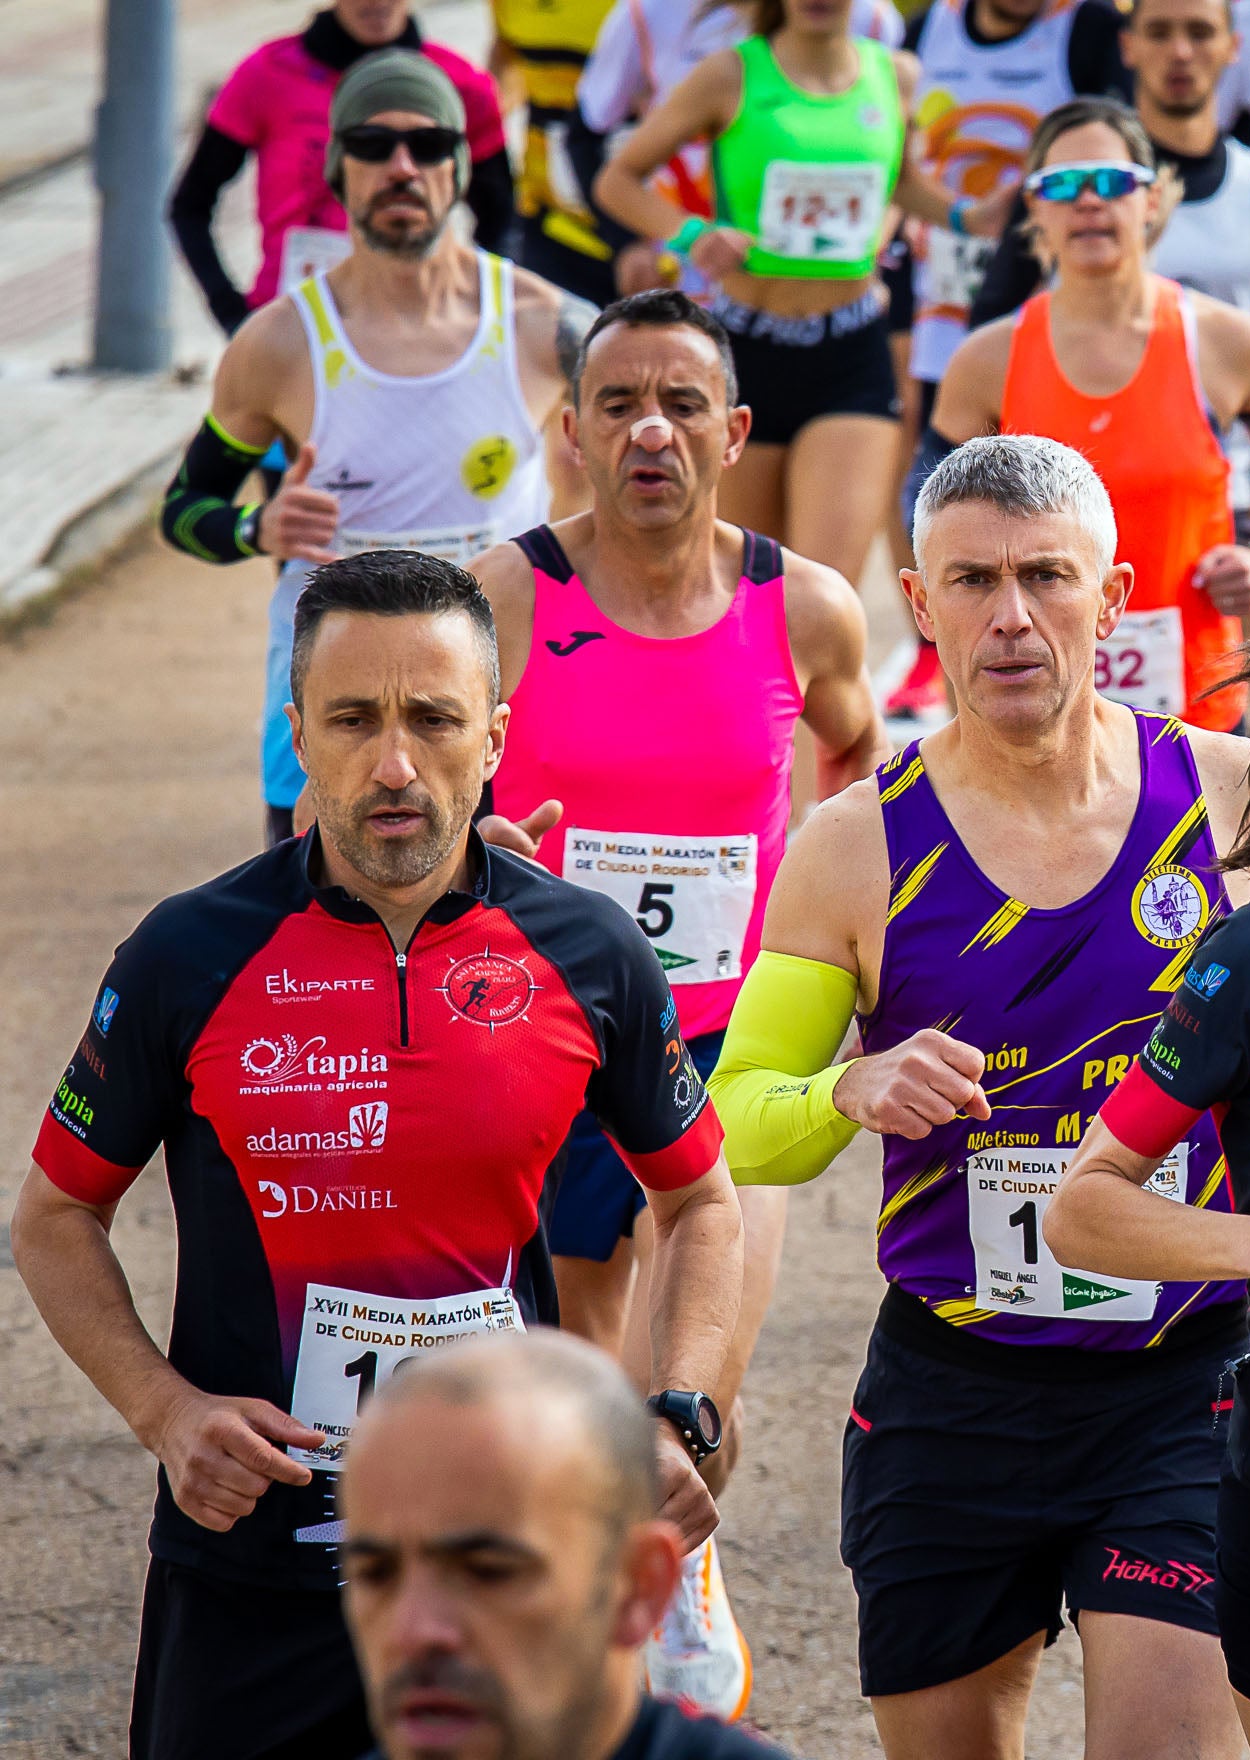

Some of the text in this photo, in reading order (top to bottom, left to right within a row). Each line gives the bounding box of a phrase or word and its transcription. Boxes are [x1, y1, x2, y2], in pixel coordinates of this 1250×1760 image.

[574, 840, 601, 853] XVII
[605, 843, 648, 857] MEDIA
[652, 846, 716, 860] MARATÓN
[575, 859, 711, 877] DE CIUDAD RODRIGO
[1142, 865, 1193, 886] ATLETISMO
[636, 882, 675, 938] 5
[1145, 926, 1204, 948] MACOTERA
[306, 1047, 389, 1081] tapia
[1082, 1053, 1140, 1090] PR
[239, 1082, 322, 1096] maquinaria
[57, 1075, 95, 1126] tapia
[246, 1126, 350, 1152] adamas
[967, 1130, 1040, 1150] Atletismo
[973, 1156, 1004, 1172] XVII
[1008, 1160, 1057, 1174] MEDIA
[1154, 1170, 1177, 1182] 2024
[978, 1178, 1057, 1195] DE CIUDAD
[291, 1185, 398, 1214] DANIEL
[309, 1298, 482, 1326] XVII MEDIA MARATÓN
[315, 1321, 338, 1338] DE
[341, 1325, 406, 1347] CIUDAD
